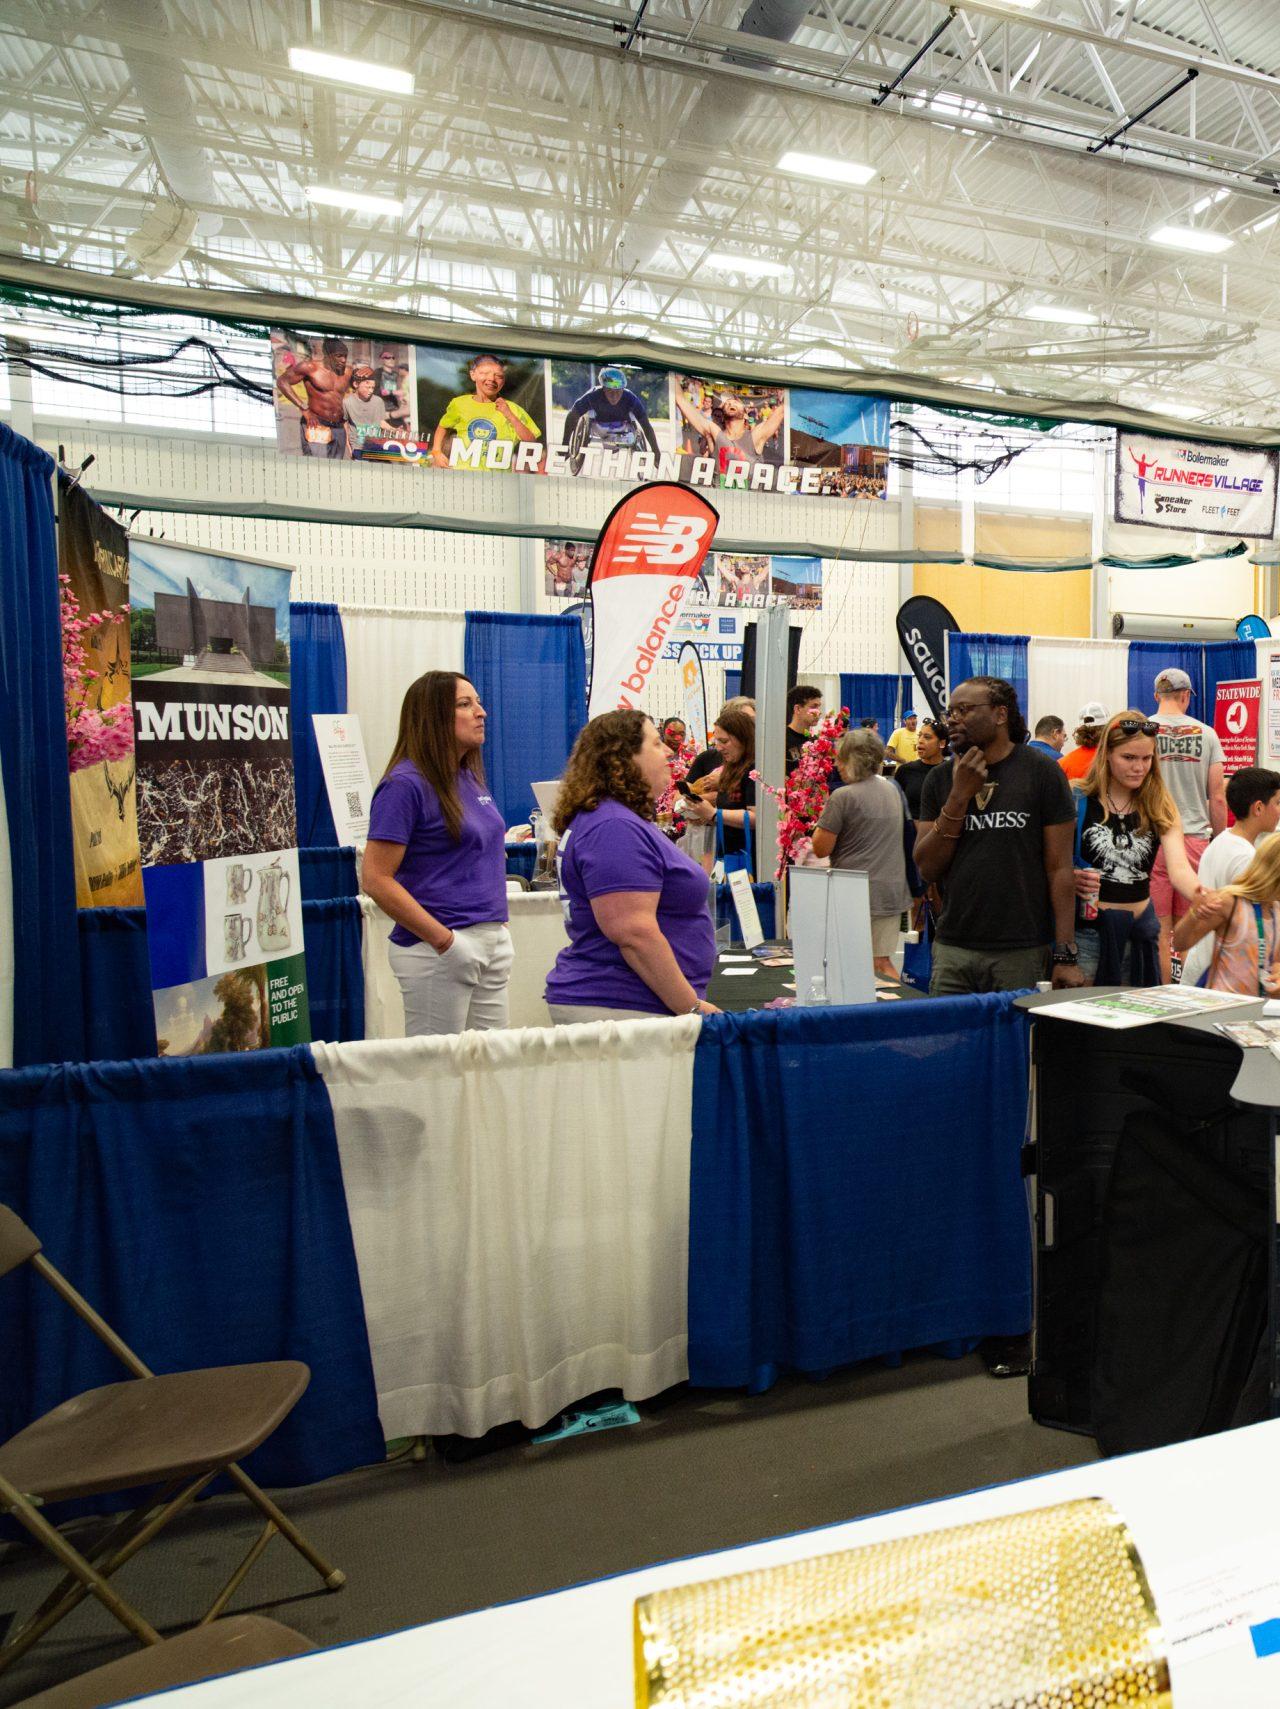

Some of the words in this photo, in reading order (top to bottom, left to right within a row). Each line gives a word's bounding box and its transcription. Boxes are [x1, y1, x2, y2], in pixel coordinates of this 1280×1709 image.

[449, 437, 570, 475] MORE
[576, 446, 682, 482] THAN
[690, 456, 716, 486] A
[724, 459, 832, 494] RACE.
[1187, 450, 1230, 467] Boilermaker
[1154, 496, 1193, 513] Sneaker
[1165, 503, 1187, 514] Store
[1202, 505, 1220, 515] FLEET
[1226, 507, 1240, 517] FEET
[685, 590, 719, 607] HAN
[724, 592, 738, 607] A
[621, 583, 684, 694] balance
[722, 646, 742, 660] UP
[1217, 687, 1260, 700] STATEWIDE
[135, 701, 289, 741] MUNSON
[270, 976, 289, 990] FREE
[271, 988, 287, 1002] AND
[288, 983, 305, 997] OPEN
[271, 1002, 282, 1014] TO
[283, 998, 297, 1010] THE
[271, 1009, 298, 1026] PUBLIC
